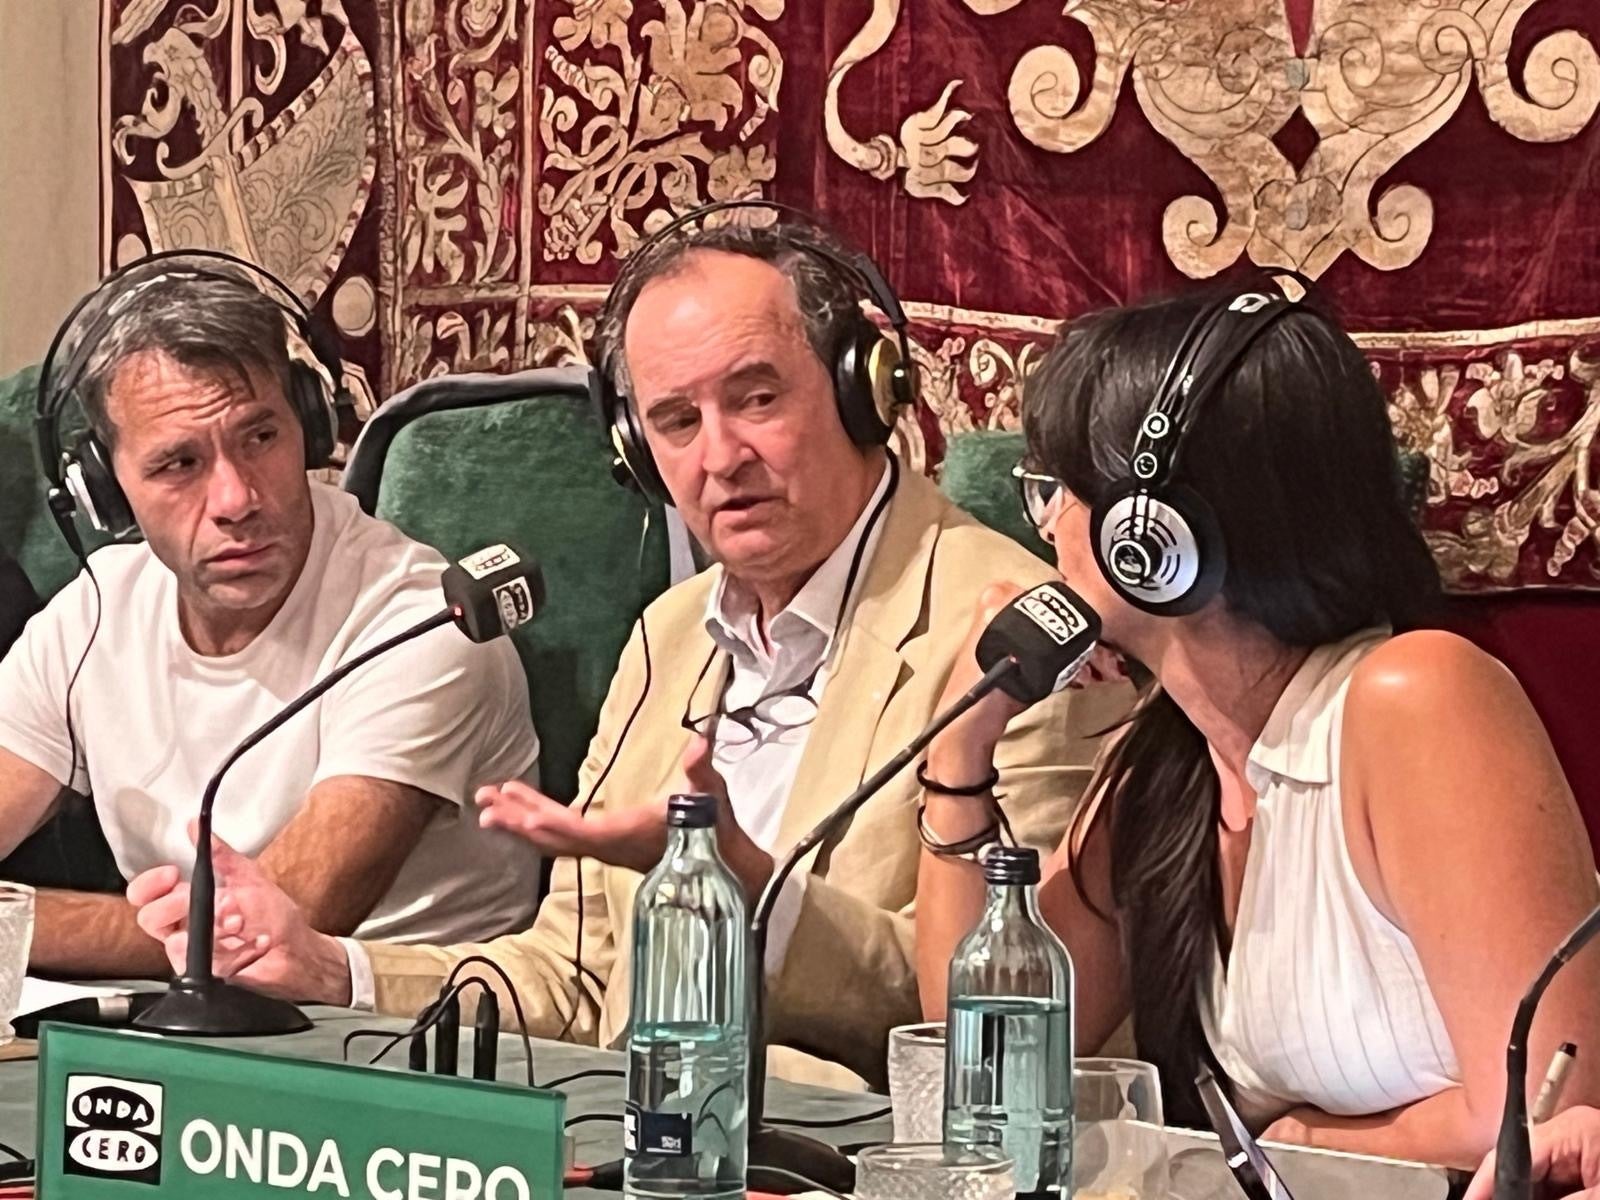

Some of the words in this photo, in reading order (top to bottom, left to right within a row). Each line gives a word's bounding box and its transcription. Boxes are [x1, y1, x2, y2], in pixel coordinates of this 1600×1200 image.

[78, 1095, 149, 1122] ONDA
[81, 1136, 146, 1164] CERO
[180, 1118, 351, 1198] ONDA
